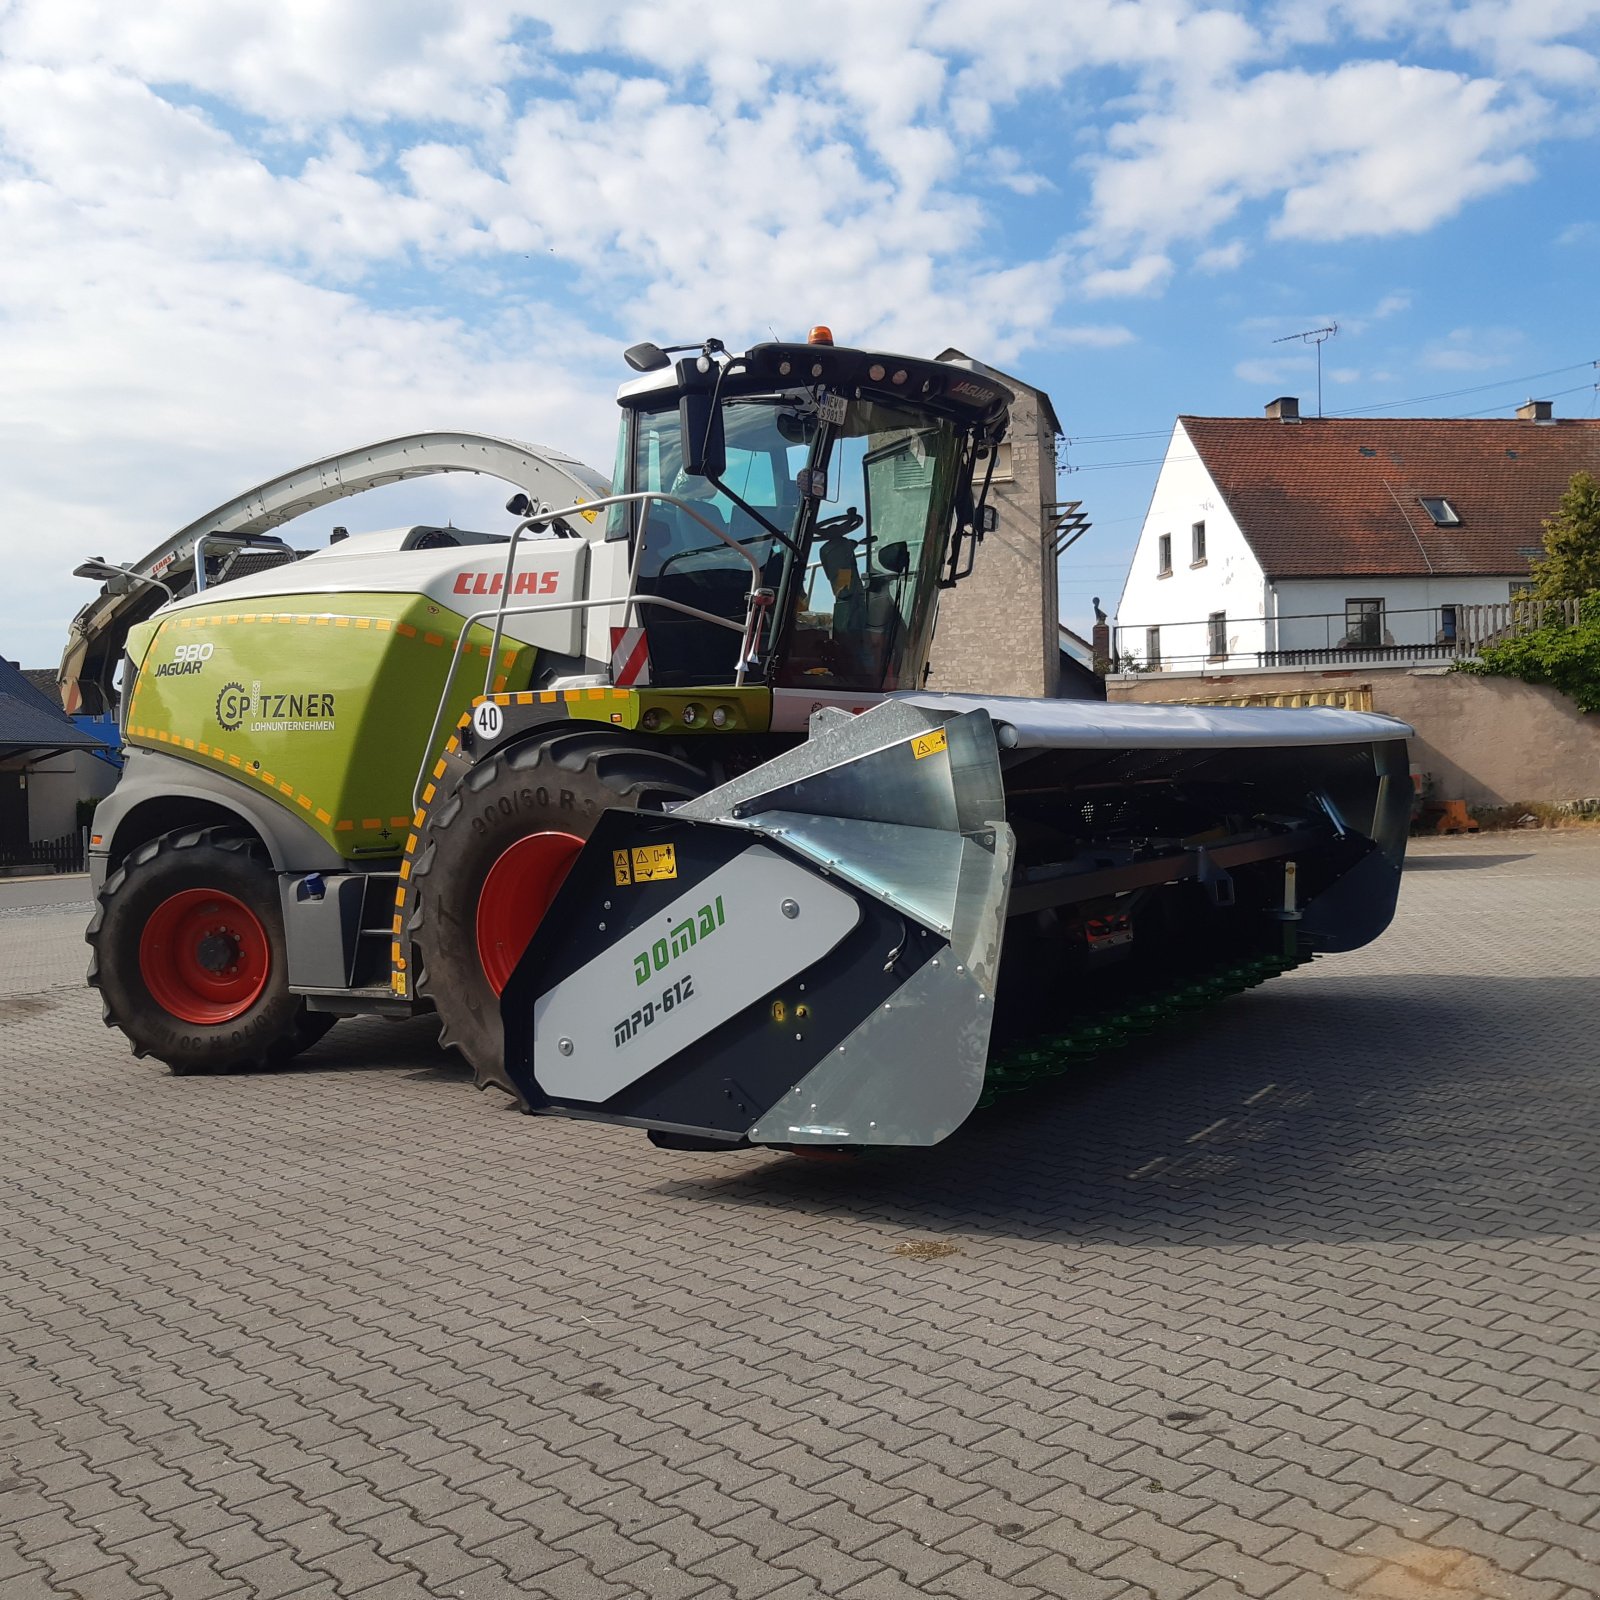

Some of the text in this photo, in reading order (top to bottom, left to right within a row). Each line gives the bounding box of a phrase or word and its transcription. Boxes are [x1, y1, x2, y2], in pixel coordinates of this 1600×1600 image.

[952, 381, 995, 401] JAGUAR
[152, 555, 172, 574] CLAAS
[453, 571, 559, 595] CLAAS
[173, 643, 214, 663] 980
[154, 660, 203, 677] JAGUAR
[251, 720, 335, 731] LOHNUNTERNEHMEN
[478, 707, 497, 732] 40
[559, 788, 576, 810] R
[614, 974, 695, 1048] MPD-612
